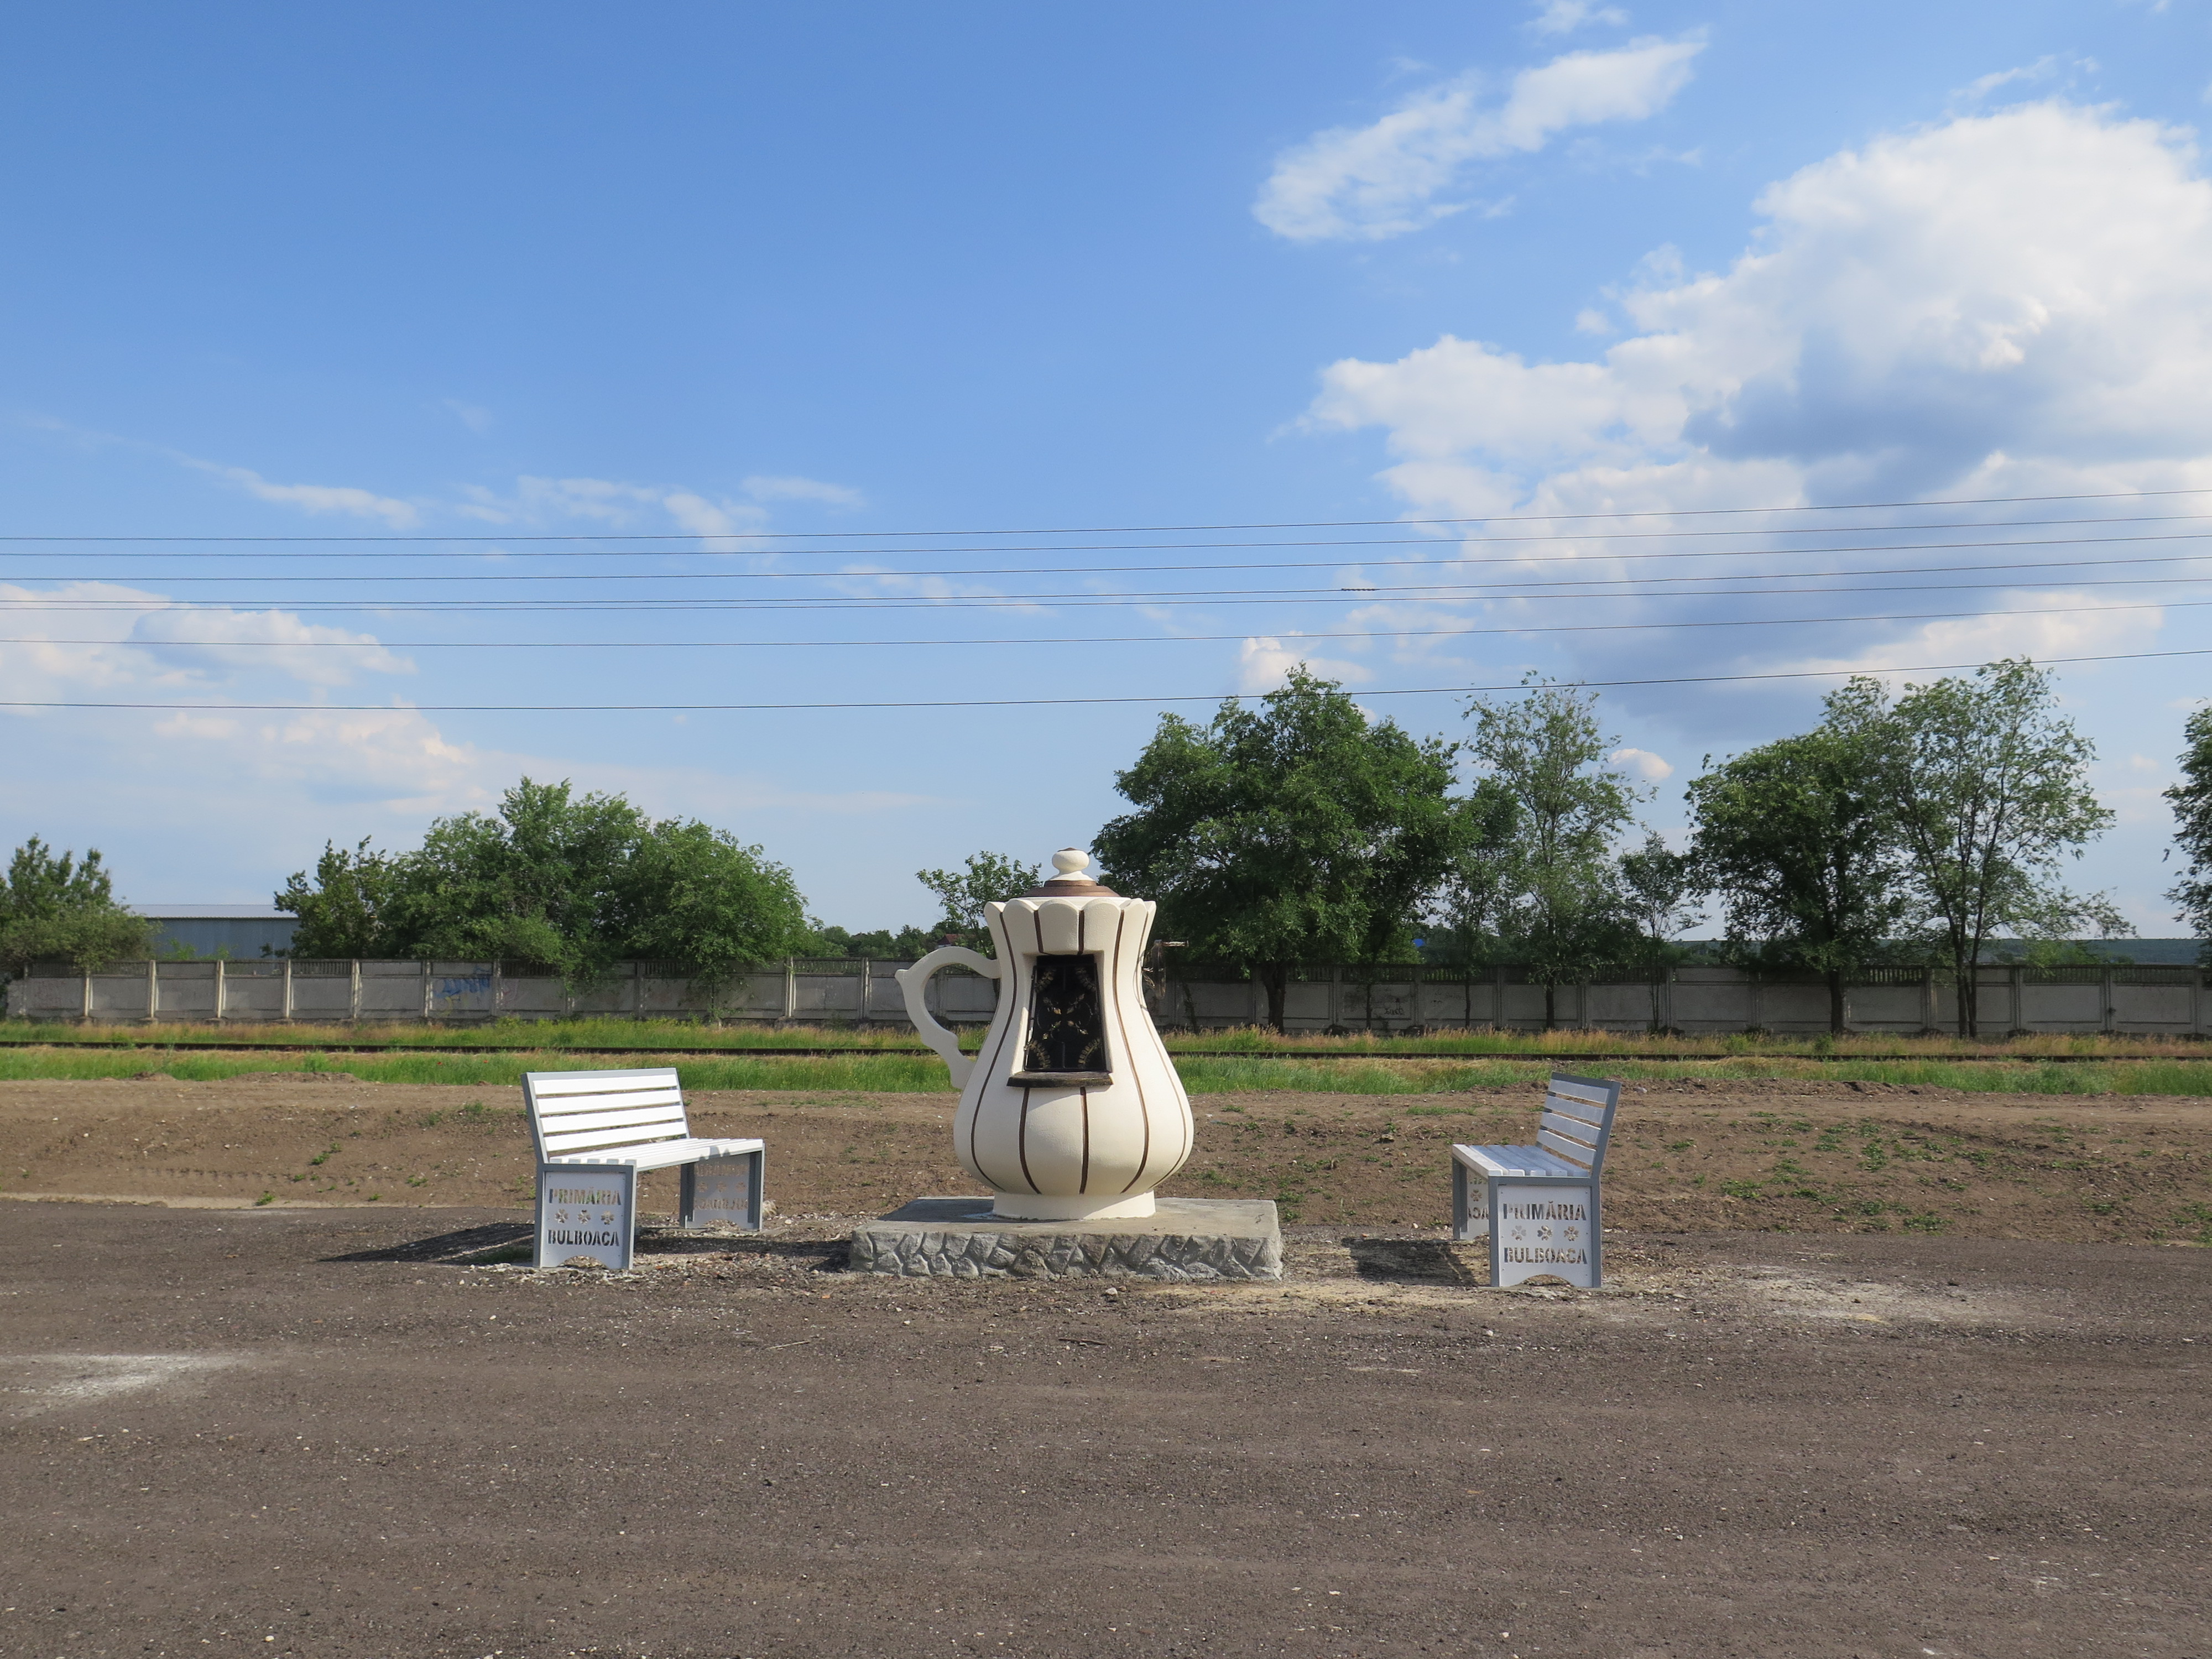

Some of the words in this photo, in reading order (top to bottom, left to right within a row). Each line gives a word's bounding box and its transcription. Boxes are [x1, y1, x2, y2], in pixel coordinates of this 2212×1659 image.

[1503, 1201, 1587, 1220] PRIMĂRIA
[548, 1229, 619, 1246] BULBOACA
[1504, 1247, 1588, 1265] BULBOACA
